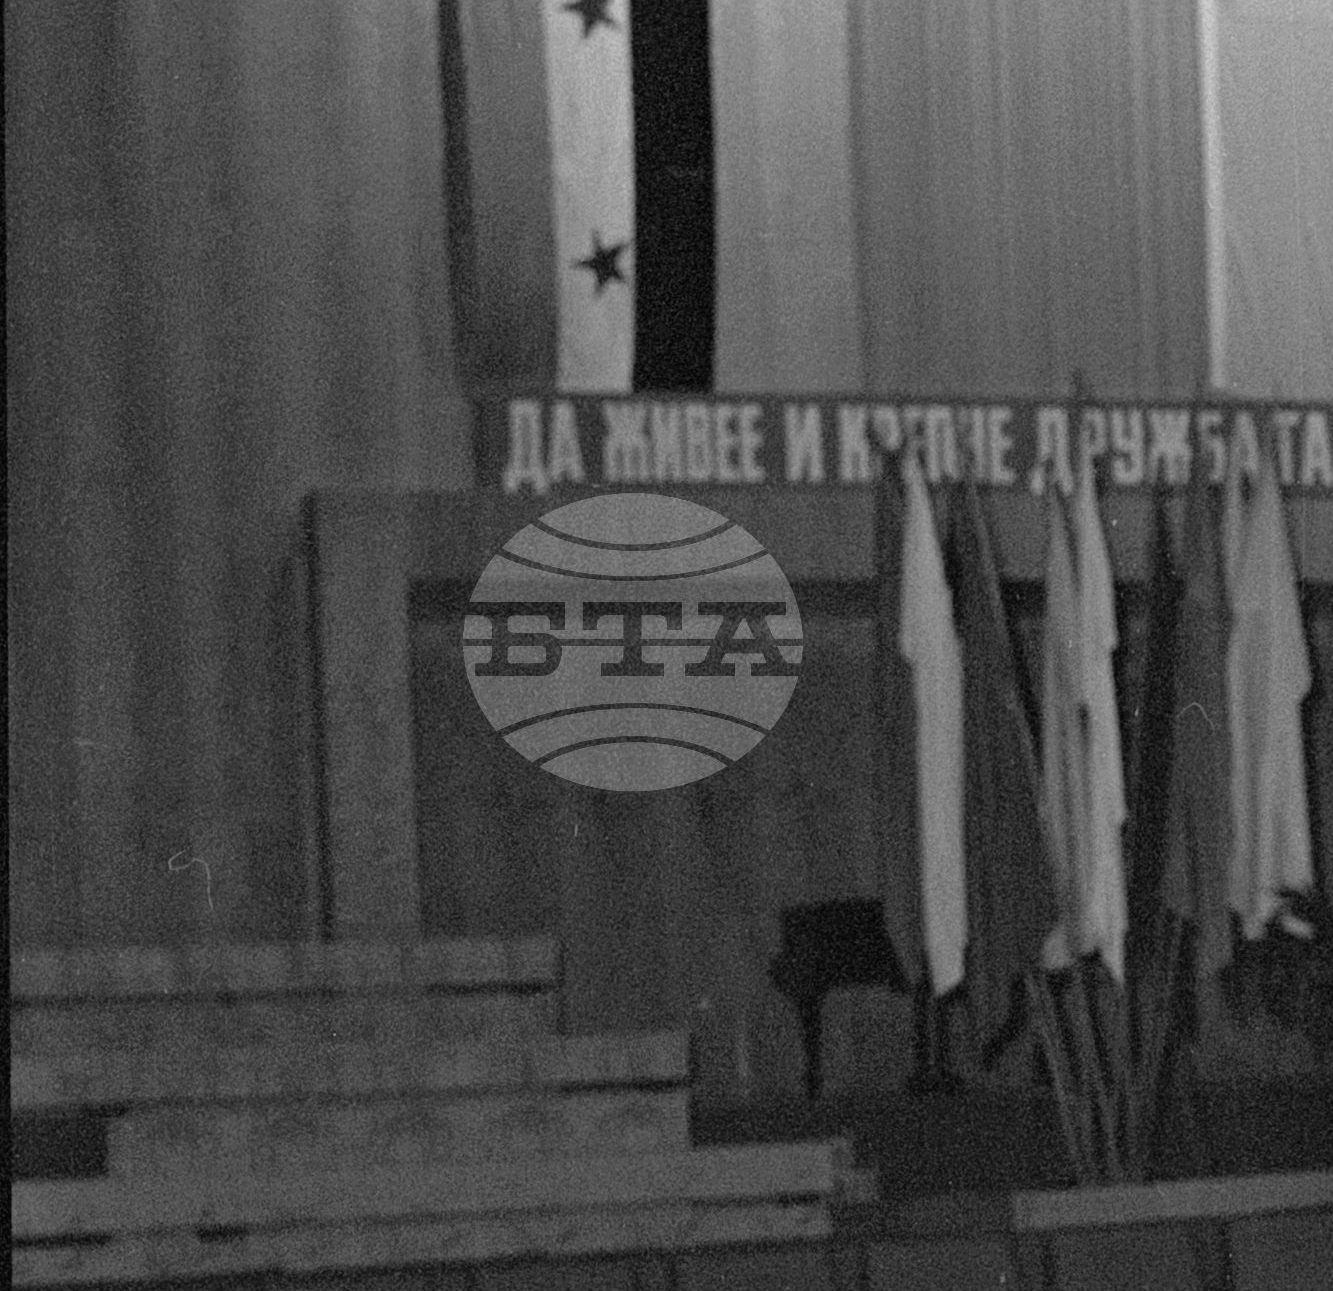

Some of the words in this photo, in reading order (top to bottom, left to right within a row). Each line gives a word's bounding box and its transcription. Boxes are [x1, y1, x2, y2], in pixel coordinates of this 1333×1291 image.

[504, 401, 585, 494] ДА
[603, 404, 765, 484] ЖИВЕЕ
[784, 405, 824, 484] И
